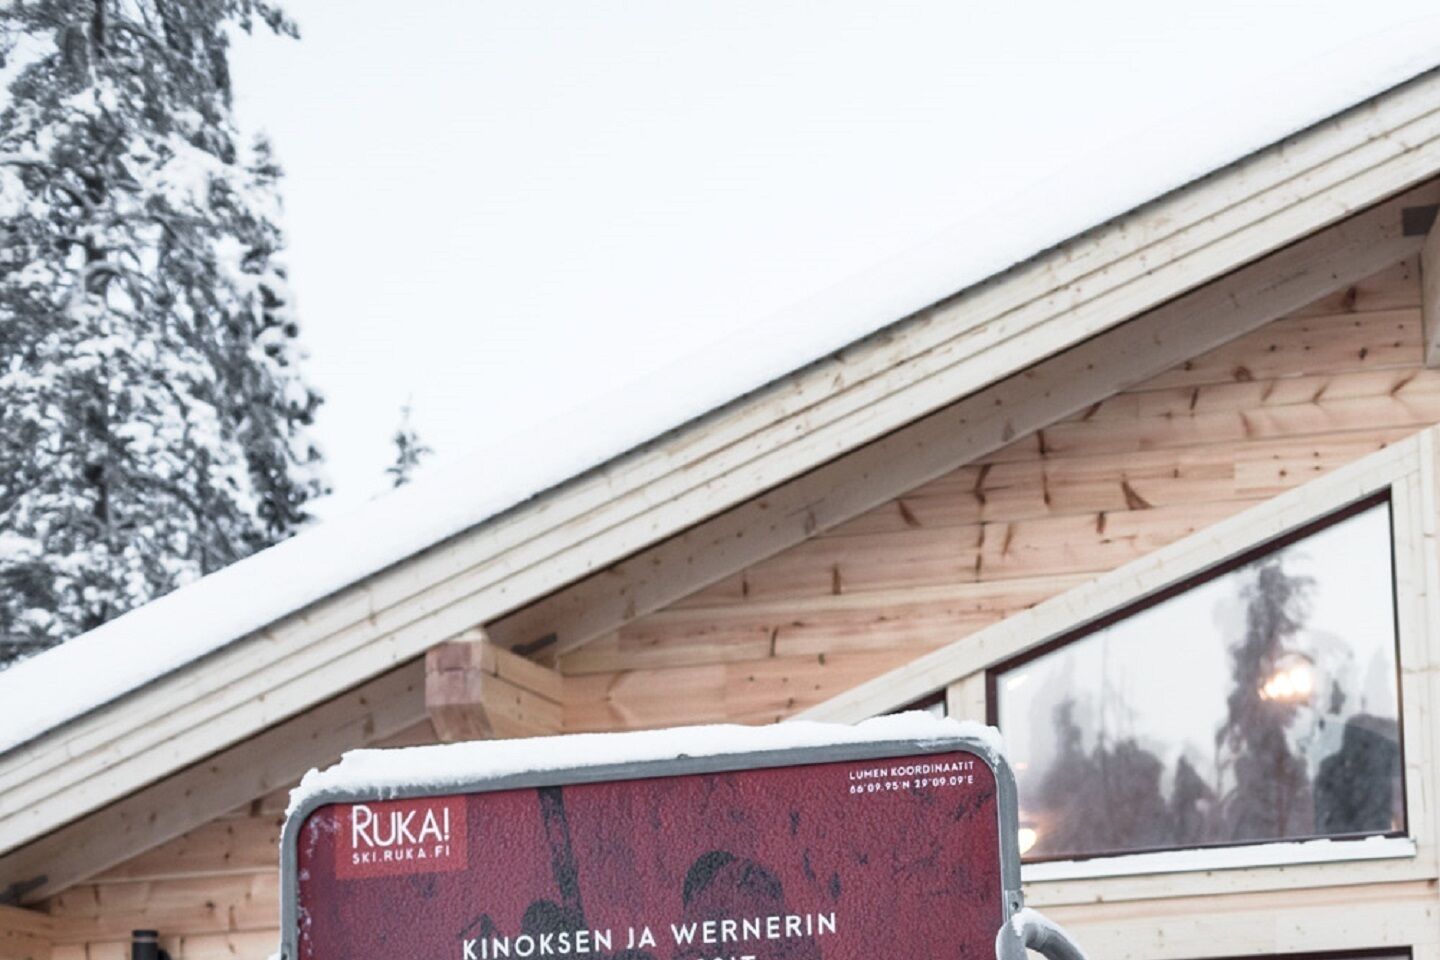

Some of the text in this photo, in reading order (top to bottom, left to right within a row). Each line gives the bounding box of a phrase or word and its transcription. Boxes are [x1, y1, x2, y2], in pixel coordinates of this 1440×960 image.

[849, 761, 975, 780] LUMEN KOORDINAATIT
[352, 804, 450, 849] RUKA!
[352, 845, 450, 865] SKI.RUKA.FI
[463, 912, 837, 960] KINOKSEN JA WERNERIN
